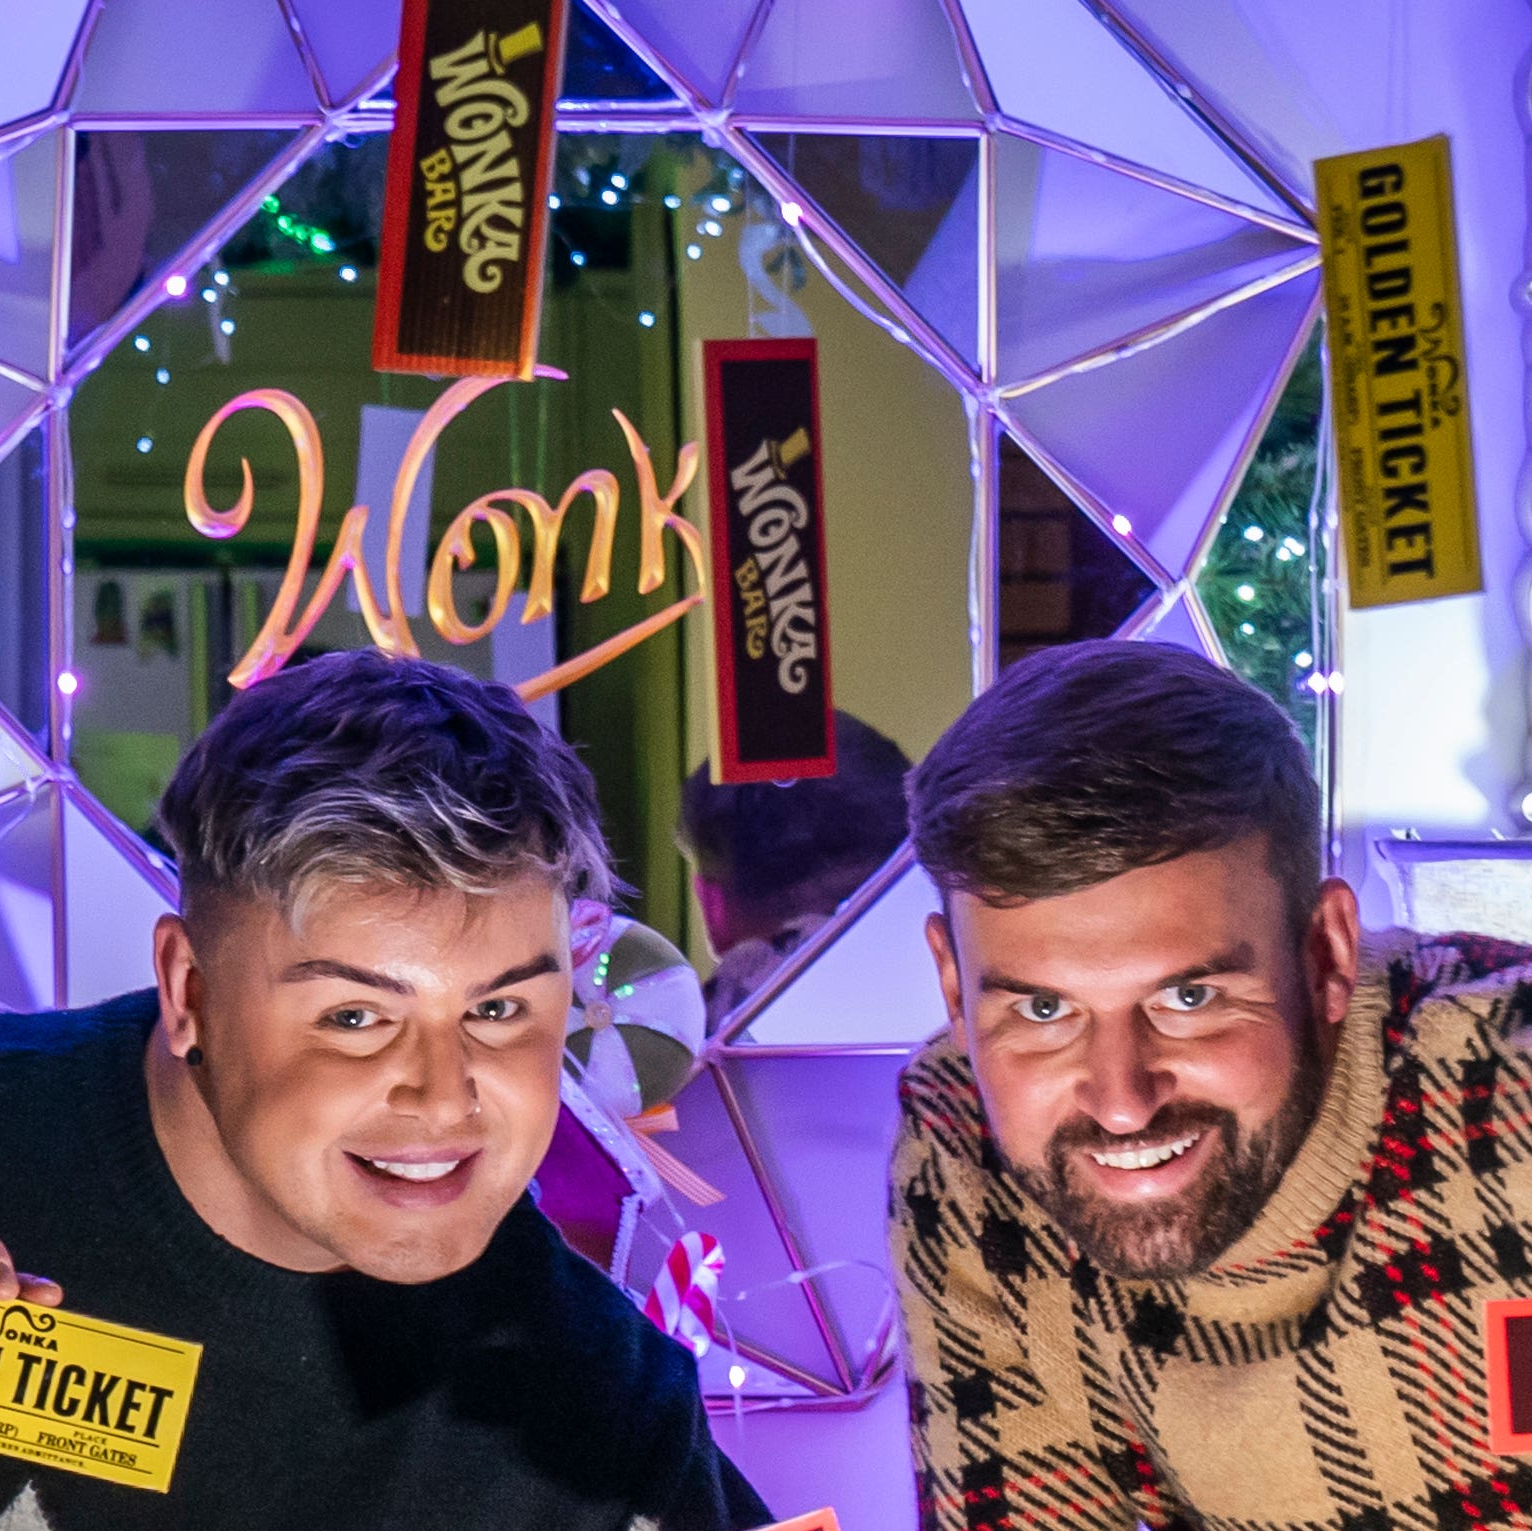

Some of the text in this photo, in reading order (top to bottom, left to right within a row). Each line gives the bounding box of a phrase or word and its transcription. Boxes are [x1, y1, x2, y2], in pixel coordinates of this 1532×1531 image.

[420, 148, 457, 252] BAR
[429, 30, 529, 293] WONKA
[1358, 163, 1435, 579] GOLDEN TICKET
[184, 363, 704, 692] Wonk
[730, 439, 817, 694] WONKA
[735, 556, 767, 660] BAR
[12, 1351, 174, 1439] TICKET
[36, 1431, 137, 1467] FRONT GATES
